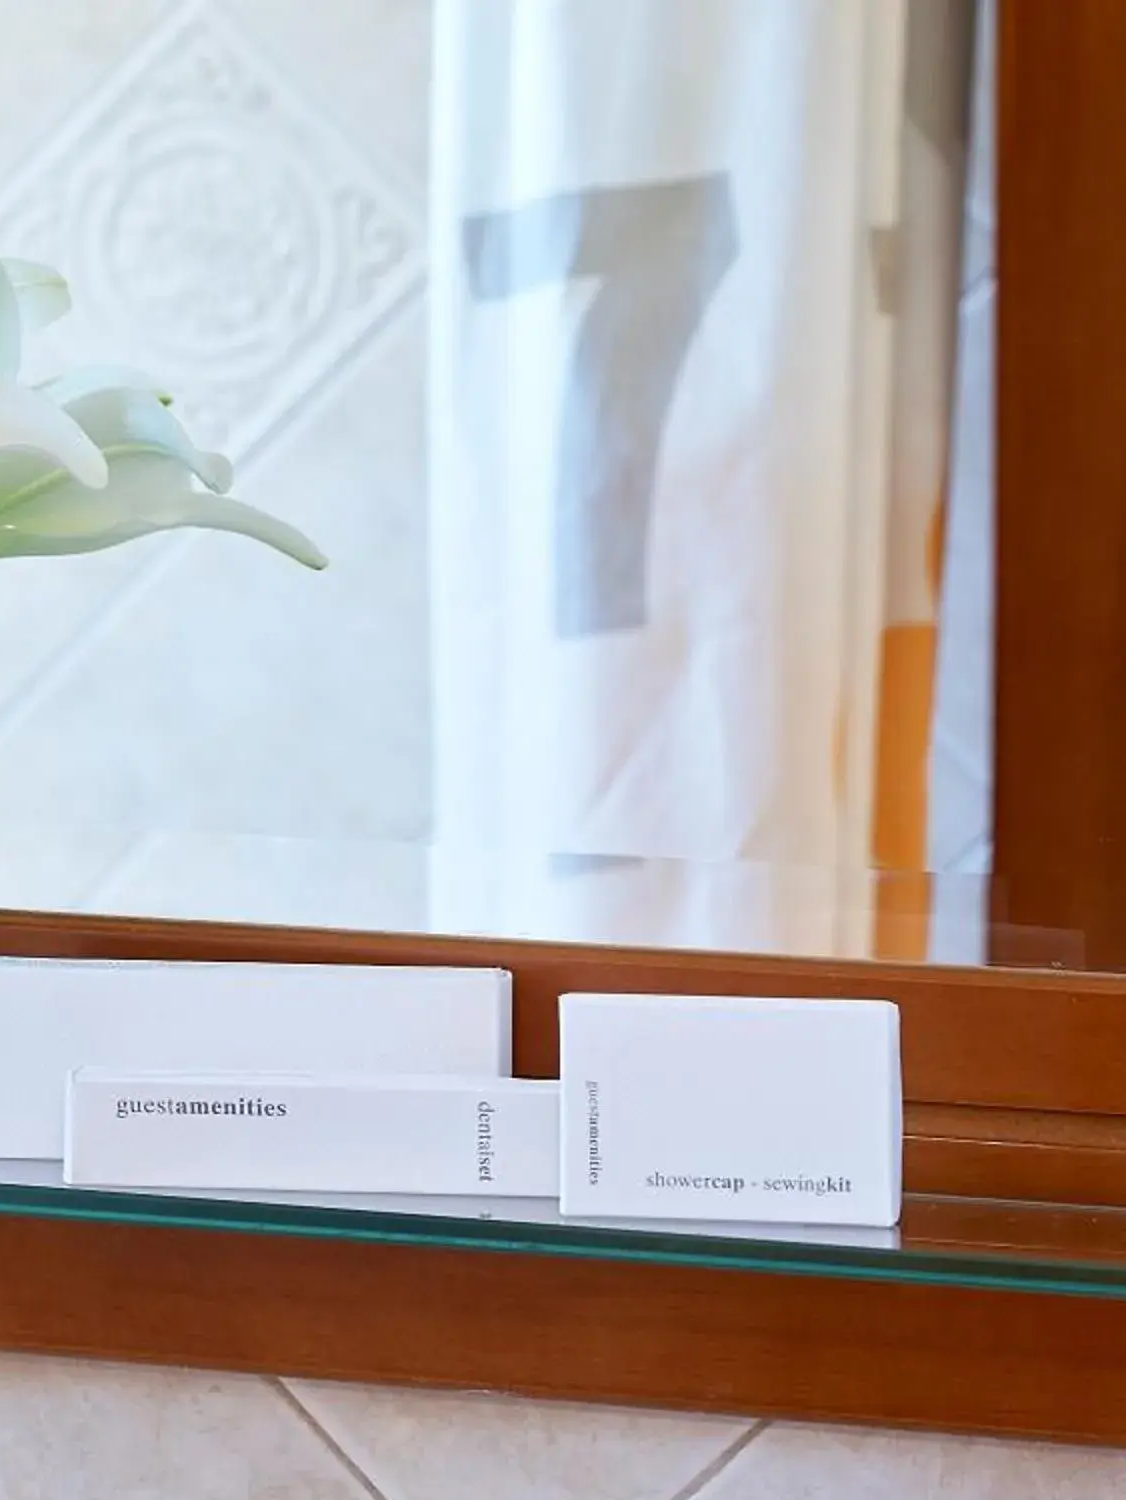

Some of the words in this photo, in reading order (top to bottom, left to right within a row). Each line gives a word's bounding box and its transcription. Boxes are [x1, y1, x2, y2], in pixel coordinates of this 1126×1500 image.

[115, 1096, 288, 1119] guestamenities
[646, 1171, 745, 1194] showercap
[762, 1173, 852, 1195] sewingkit
